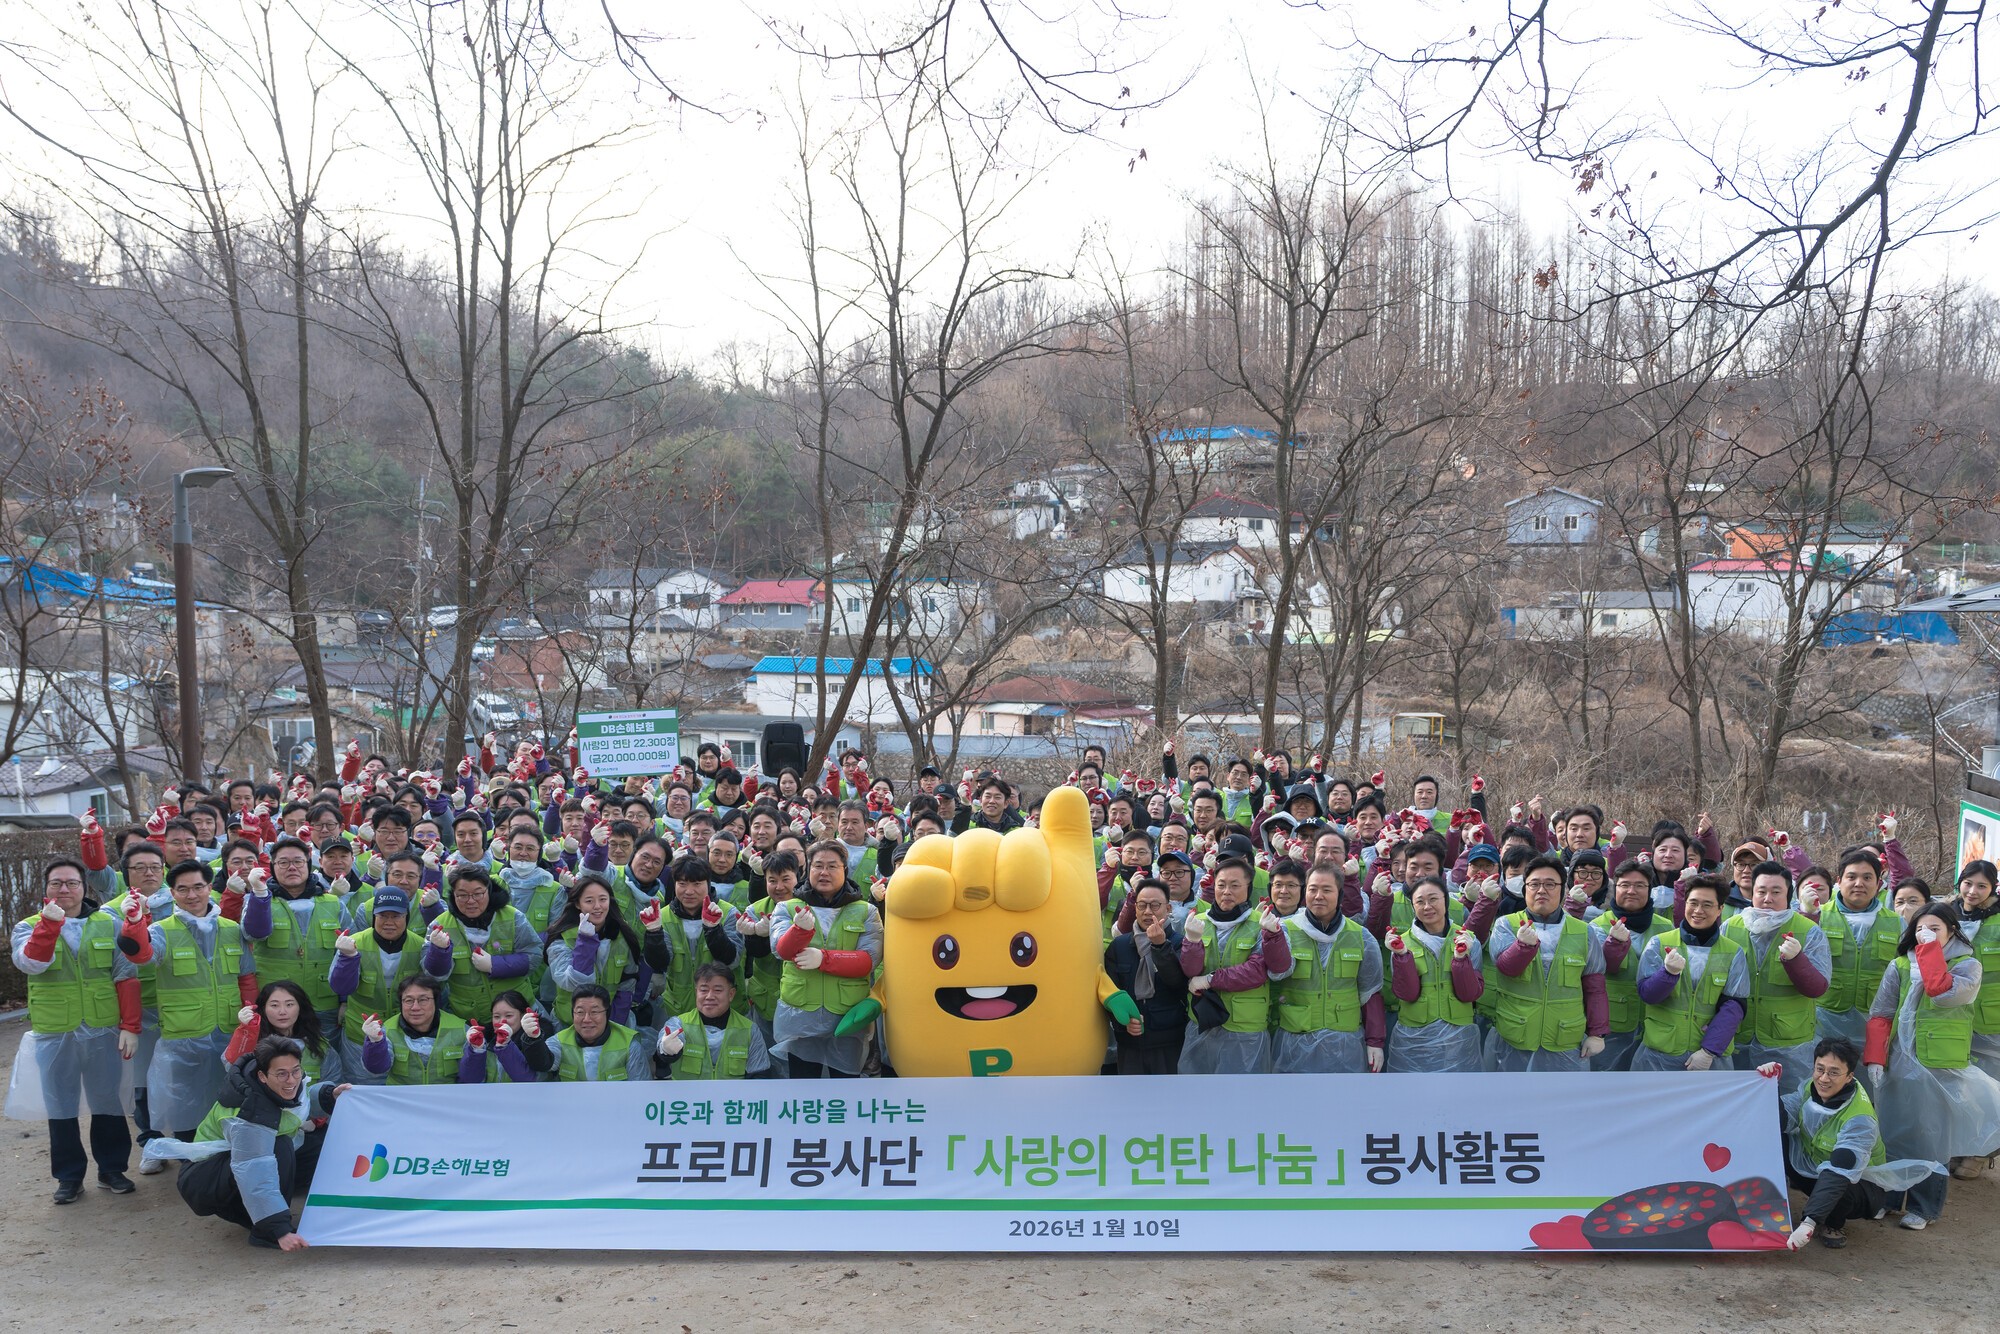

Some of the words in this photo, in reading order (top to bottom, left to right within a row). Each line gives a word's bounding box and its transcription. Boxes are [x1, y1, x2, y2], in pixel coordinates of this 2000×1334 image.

[601, 722, 655, 734] DB손해보험
[582, 740, 609, 751] 사랑의
[613, 739, 631, 750] 연탄
[646, 1101, 713, 1125] 이웃과
[724, 1100, 768, 1125] 함께
[778, 1099, 847, 1124] 사랑을
[858, 1099, 927, 1123] 나누는
[393, 1157, 510, 1177] DB손해보험
[636, 1138, 771, 1188] 프로미
[787, 1136, 923, 1187] 봉사단
[1124, 1134, 1214, 1185] 연탄
[1361, 1131, 1545, 1186] 봉사활동
[1009, 1219, 1085, 1237] 2026년
[1093, 1219, 1126, 1237] 1월
[1134, 1219, 1180, 1237] 10일
